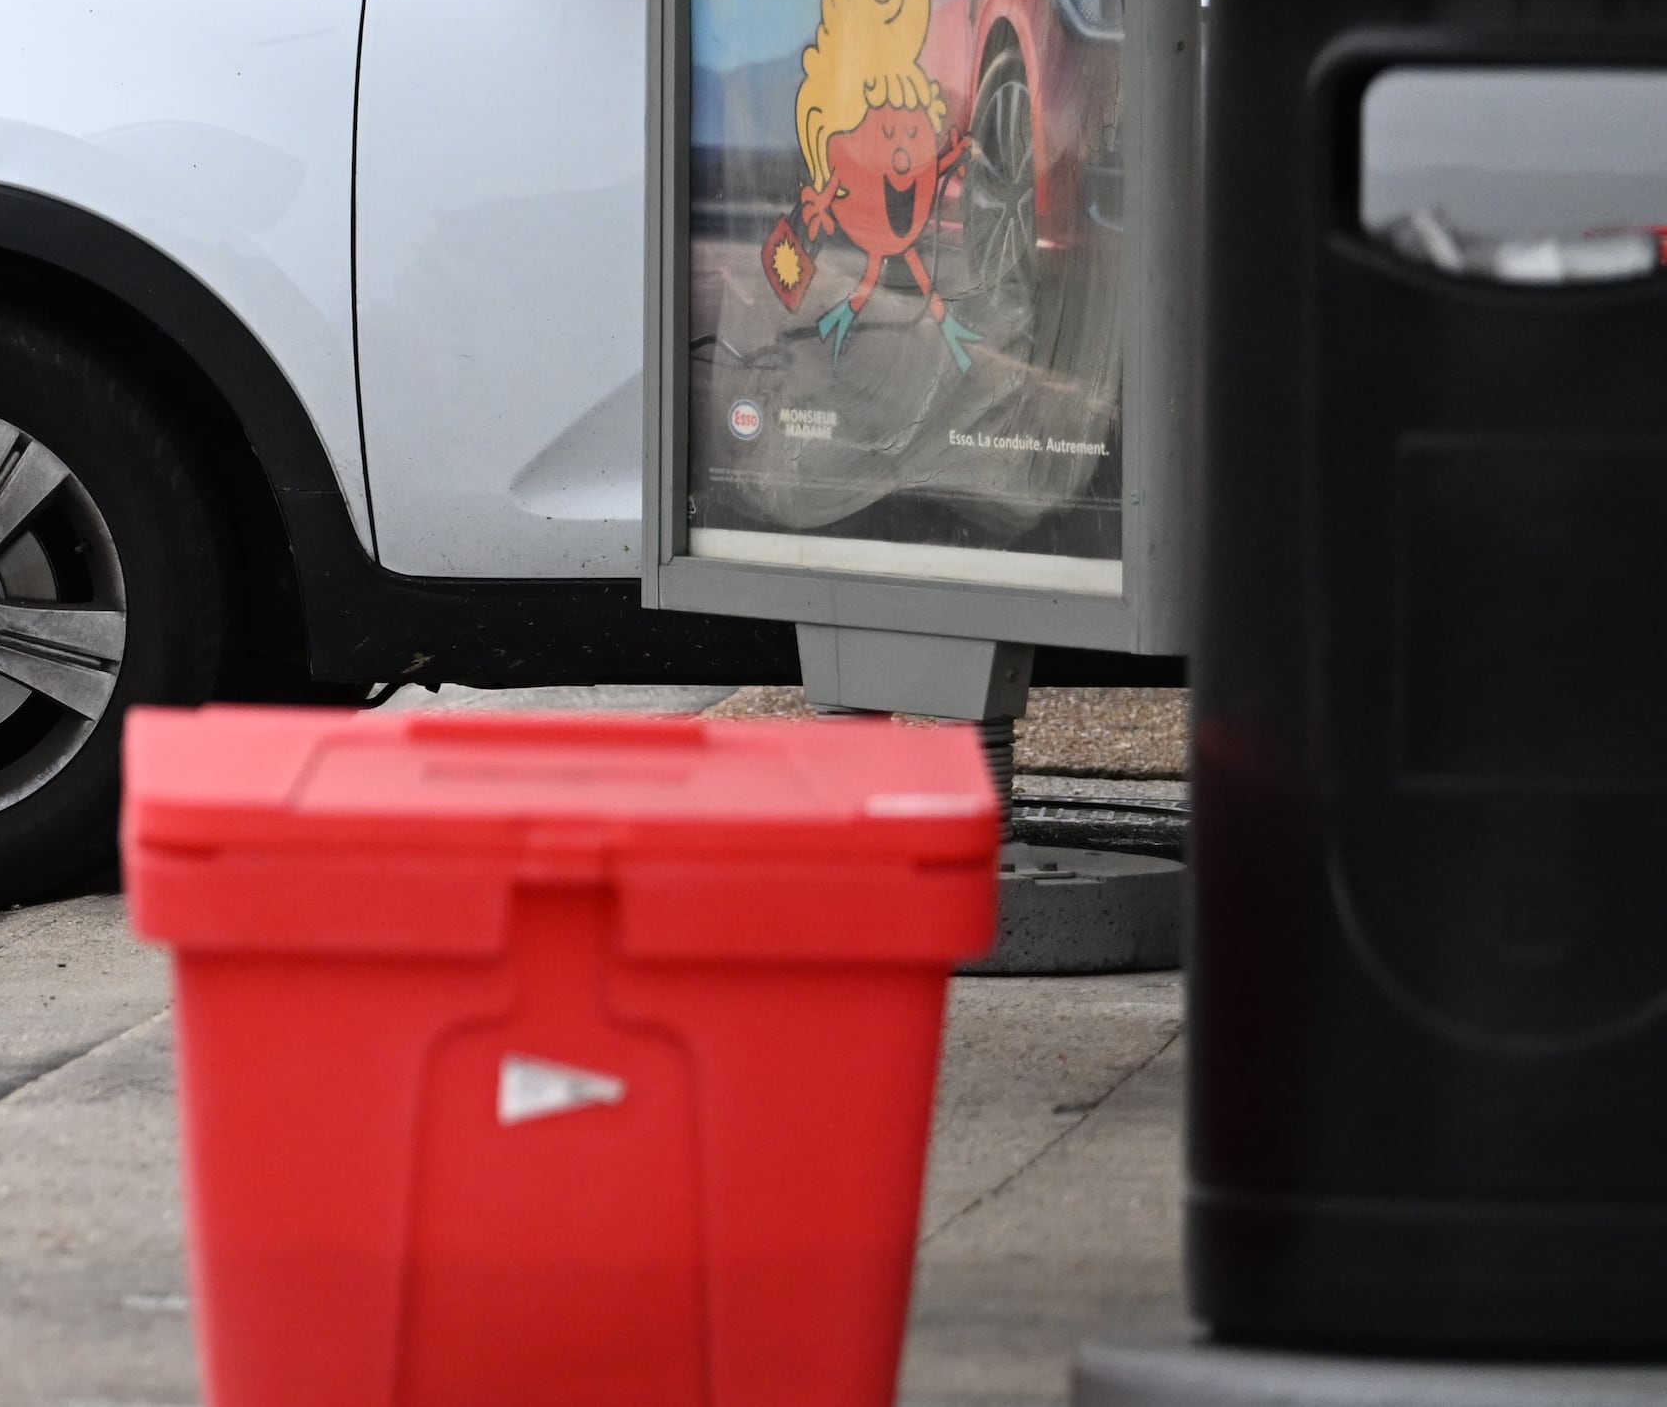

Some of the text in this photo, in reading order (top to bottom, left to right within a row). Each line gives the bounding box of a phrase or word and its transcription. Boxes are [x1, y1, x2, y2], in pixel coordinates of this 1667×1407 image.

[735, 410, 758, 427] Esso
[779, 408, 837, 427] MONSIEUR
[948, 430, 1110, 456] Esso. La conduite. Autrement.
